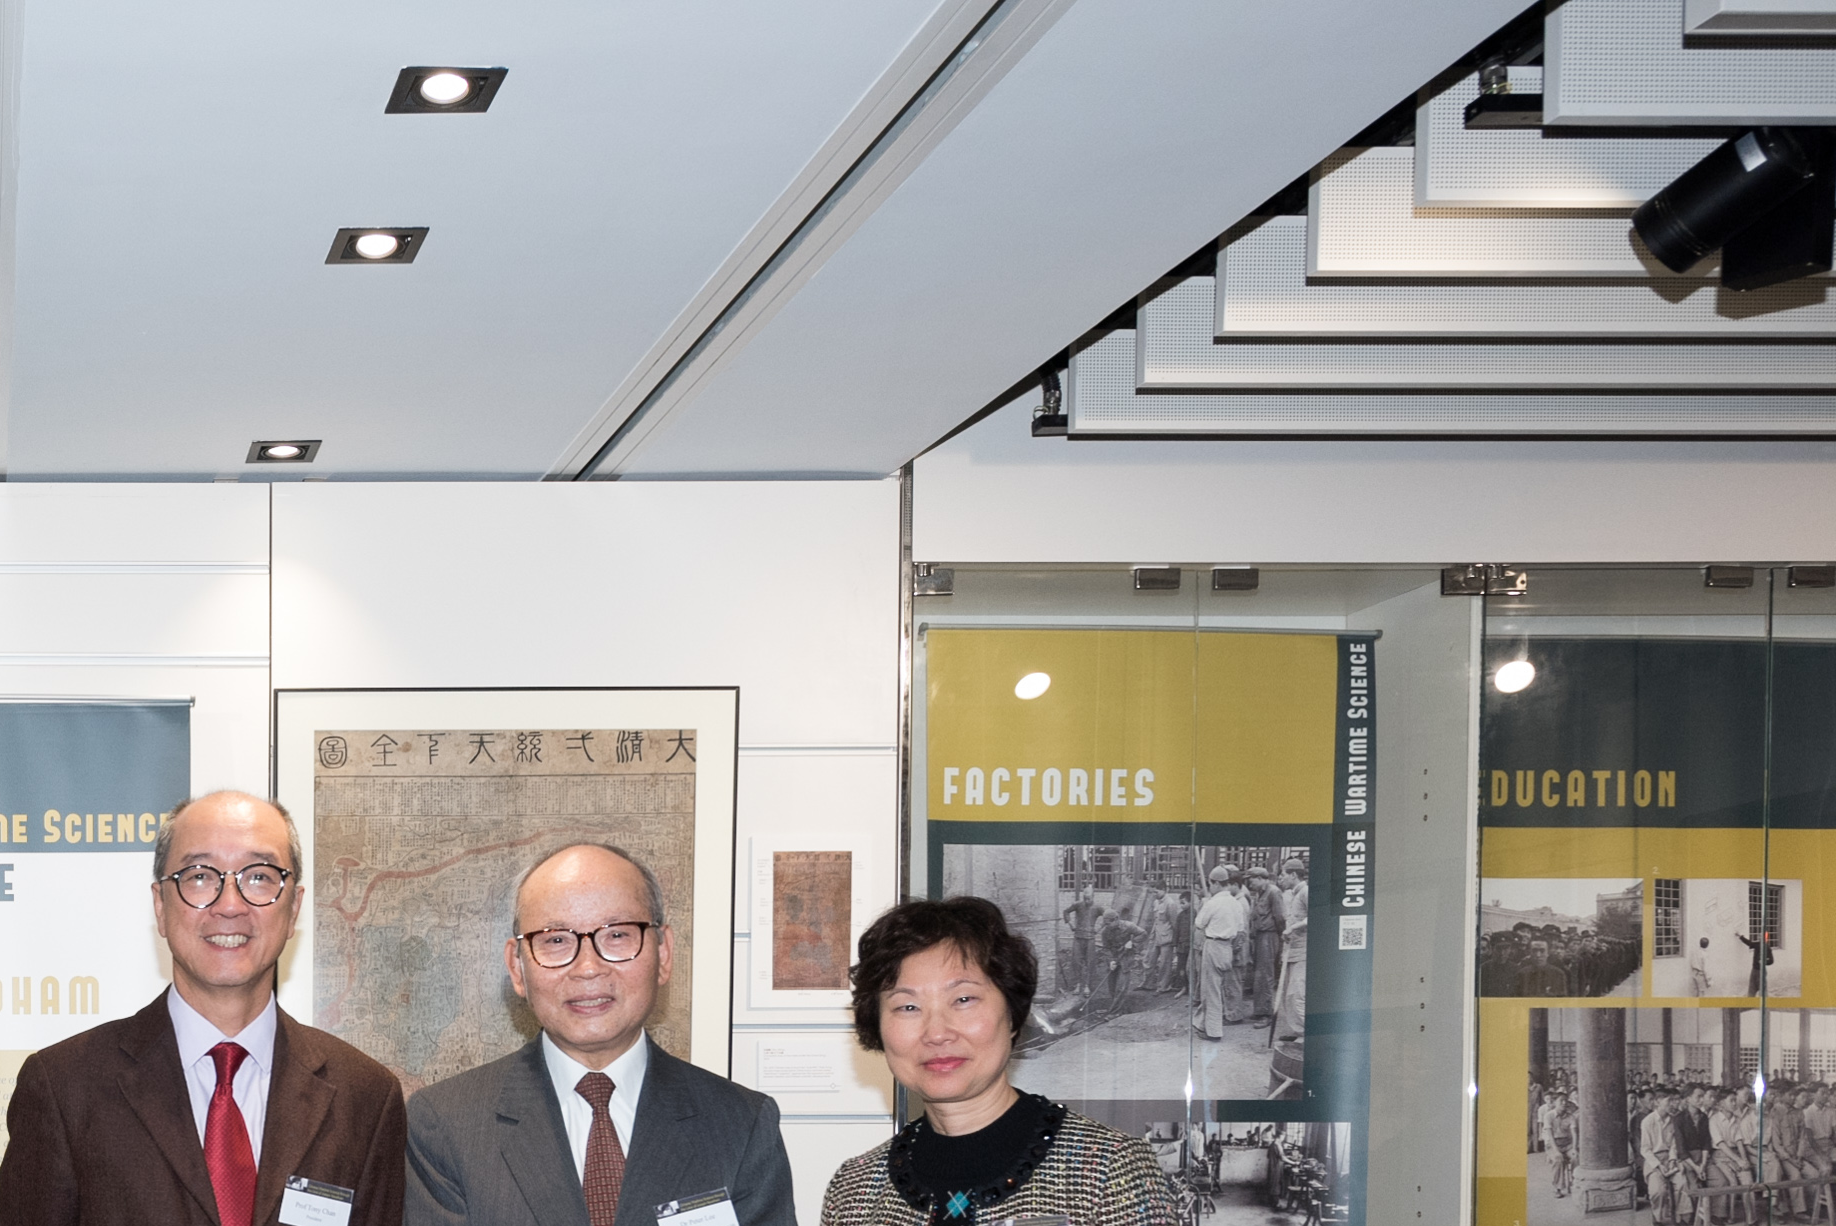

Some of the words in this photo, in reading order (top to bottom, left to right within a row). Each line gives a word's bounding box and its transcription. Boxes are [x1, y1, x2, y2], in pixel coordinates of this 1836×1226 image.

[944, 767, 1154, 806] FACTORIES
[1478, 769, 1676, 808] DUCATION
[44, 810, 170, 843] SCIENC
